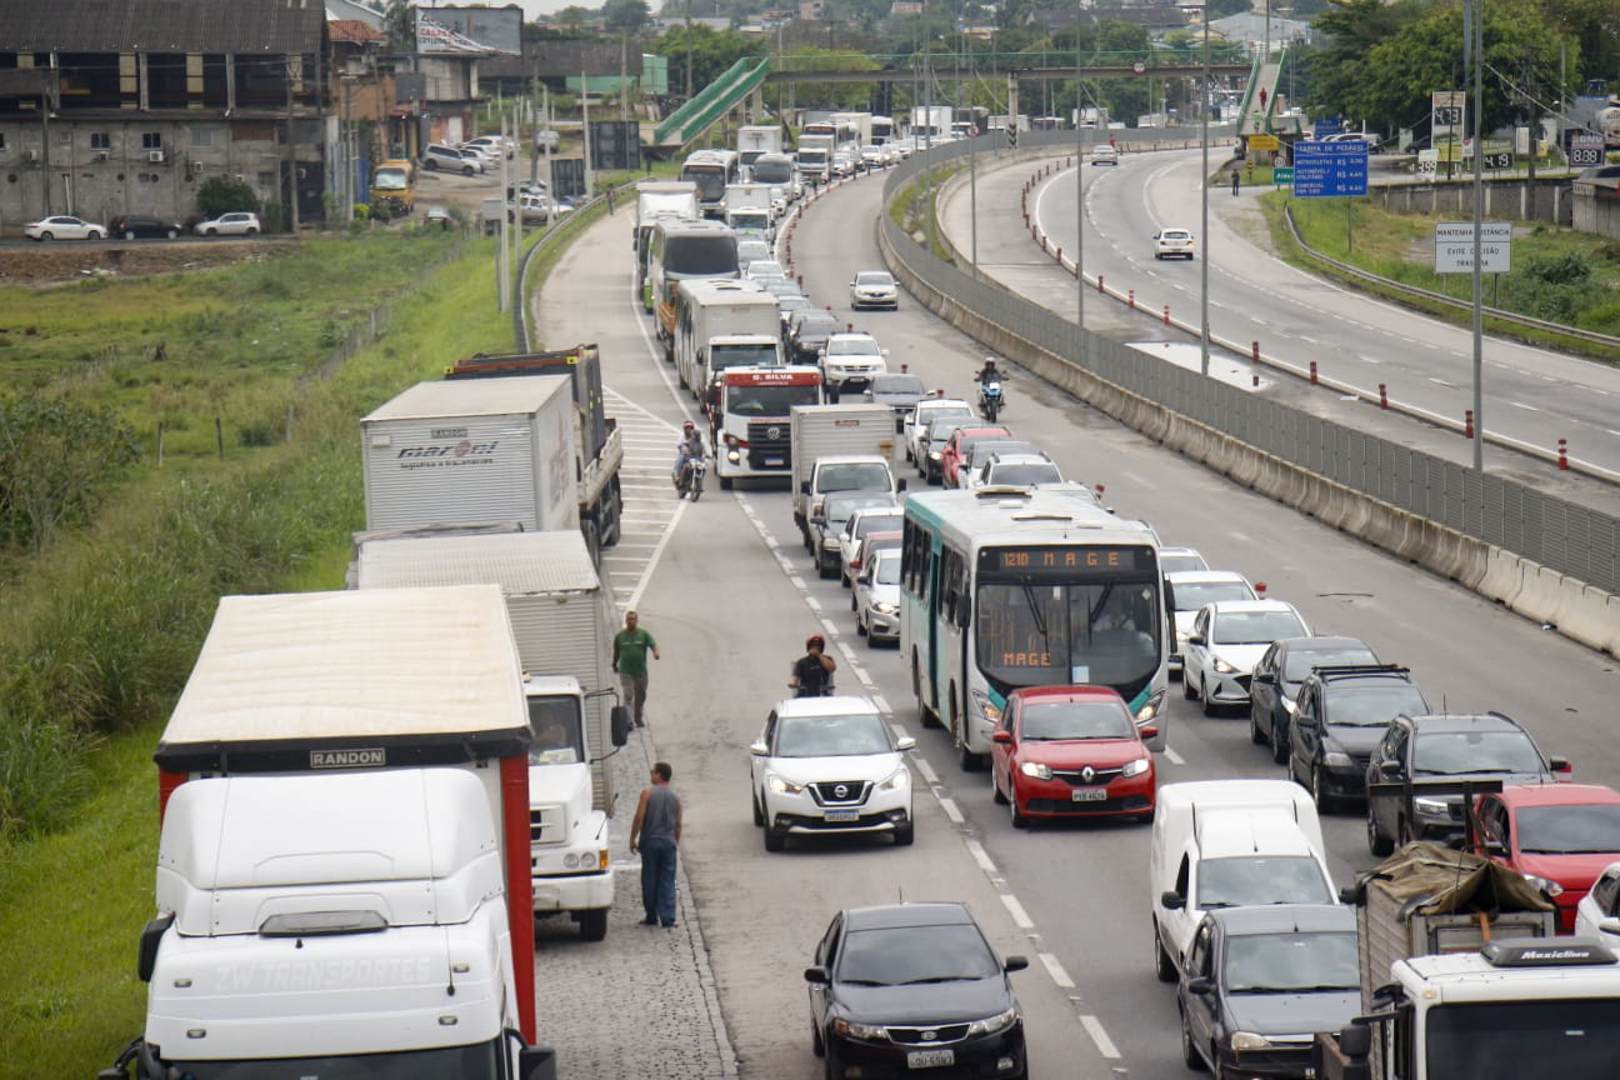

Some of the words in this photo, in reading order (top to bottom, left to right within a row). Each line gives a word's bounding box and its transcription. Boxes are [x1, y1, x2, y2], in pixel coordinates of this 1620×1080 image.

[1324, 143, 1333, 152] DE
[1337, 158, 1347, 166] R$
[1337, 171, 1347, 179] R$
[1337, 184, 1347, 192] R$
[1480, 228, 1510, 236] ISTÂNCIA
[1004, 552, 1029, 567] 1210
[1004, 653, 1051, 666] MAGE
[313, 752, 381, 765] RANDON
